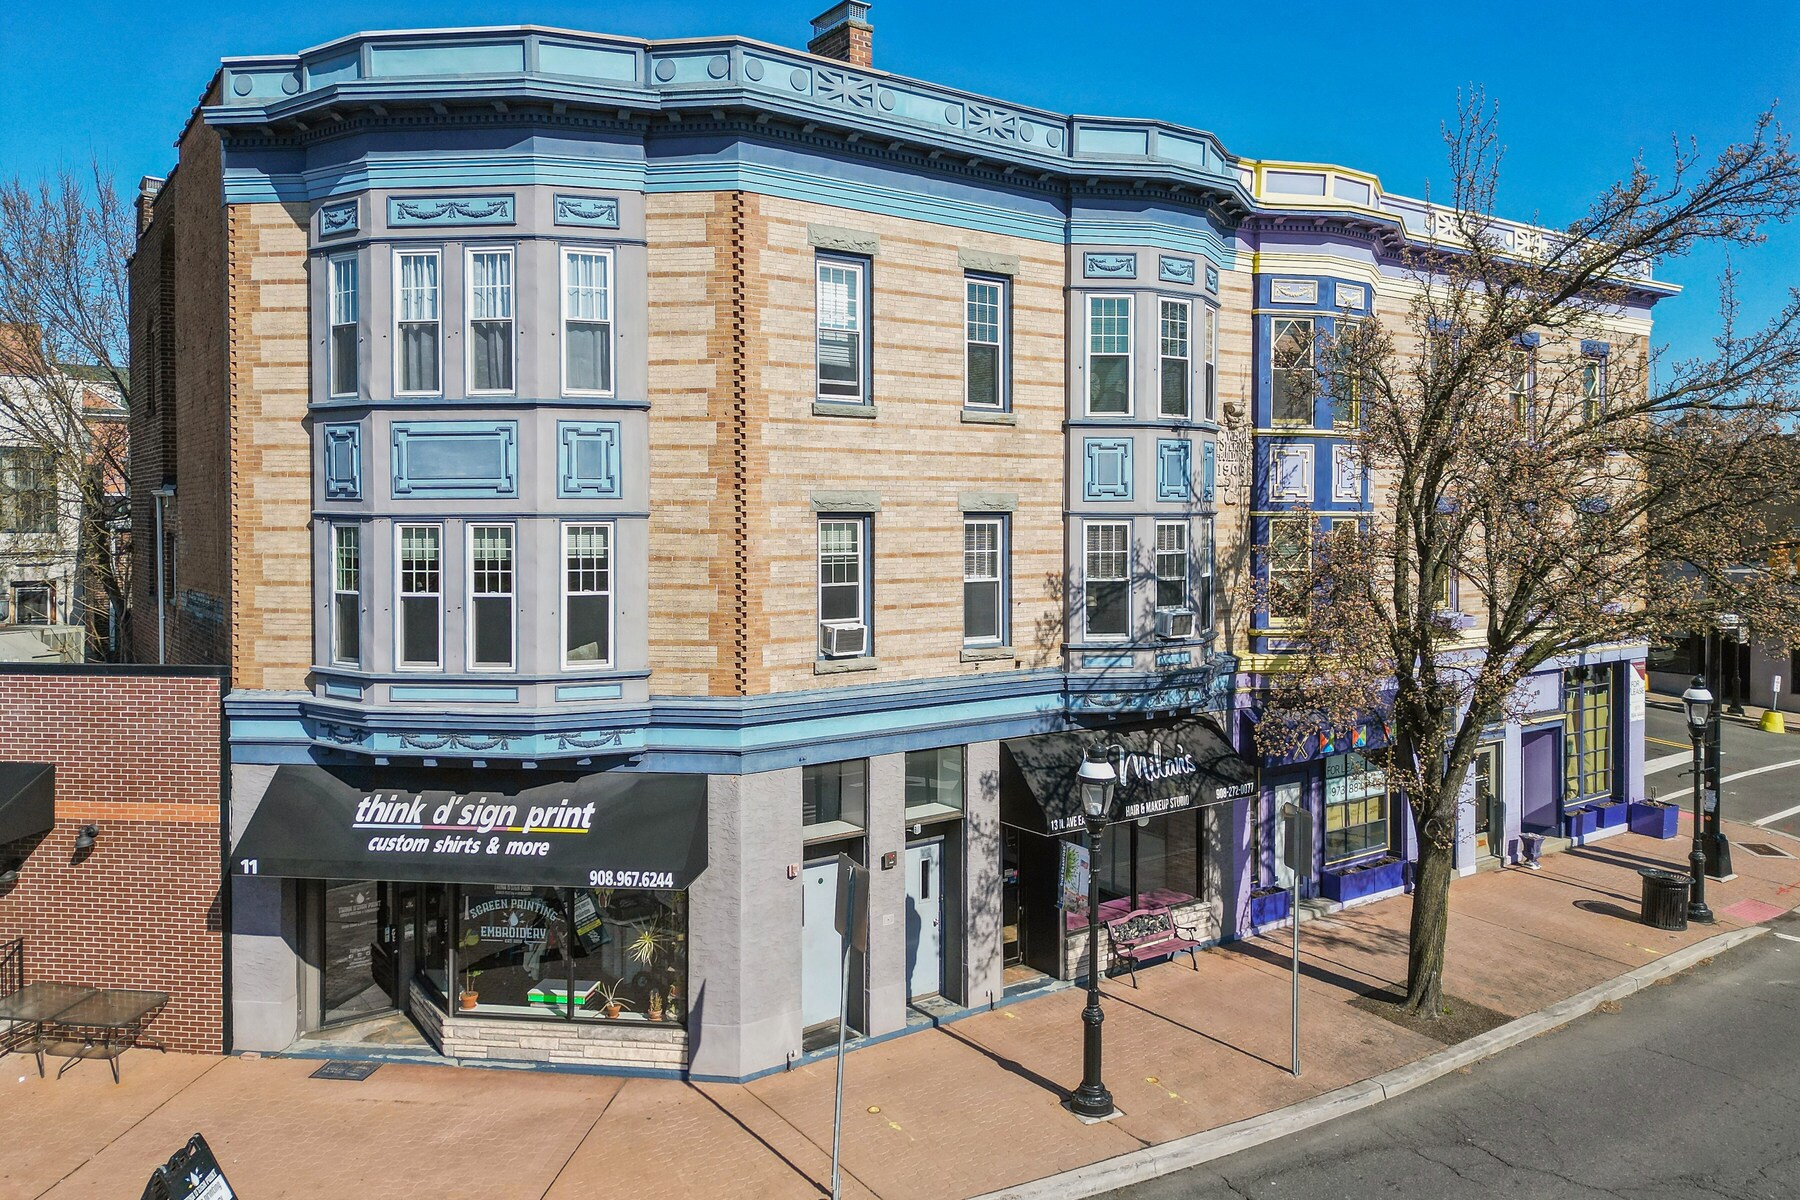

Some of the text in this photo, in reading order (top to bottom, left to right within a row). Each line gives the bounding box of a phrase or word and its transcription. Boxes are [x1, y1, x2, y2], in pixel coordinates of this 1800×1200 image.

[1631, 680, 1640, 688] FOR
[1631, 687, 1644, 696] LEASE
[1106, 740, 1197, 787] Milan's
[1327, 764, 1340, 775] FOR
[1216, 782, 1254, 800] 908-272-0077
[1331, 785, 1345, 797] 973
[355, 794, 596, 834] think d'sign print
[1125, 795, 1190, 817] HAIR & MAKEUP STUDIO
[1050, 819, 1059, 831] 13
[1066, 815, 1077, 828] AVE
[1078, 814, 1086, 826] EA
[368, 834, 550, 856] custom shirts & more
[240, 859, 258, 874] 11
[589, 870, 674, 888] 908.967.6244
[469, 899, 508, 919] SCREEN
[510, 899, 558, 922] PRINTING
[481, 926, 547, 939] EMBROIDERY
